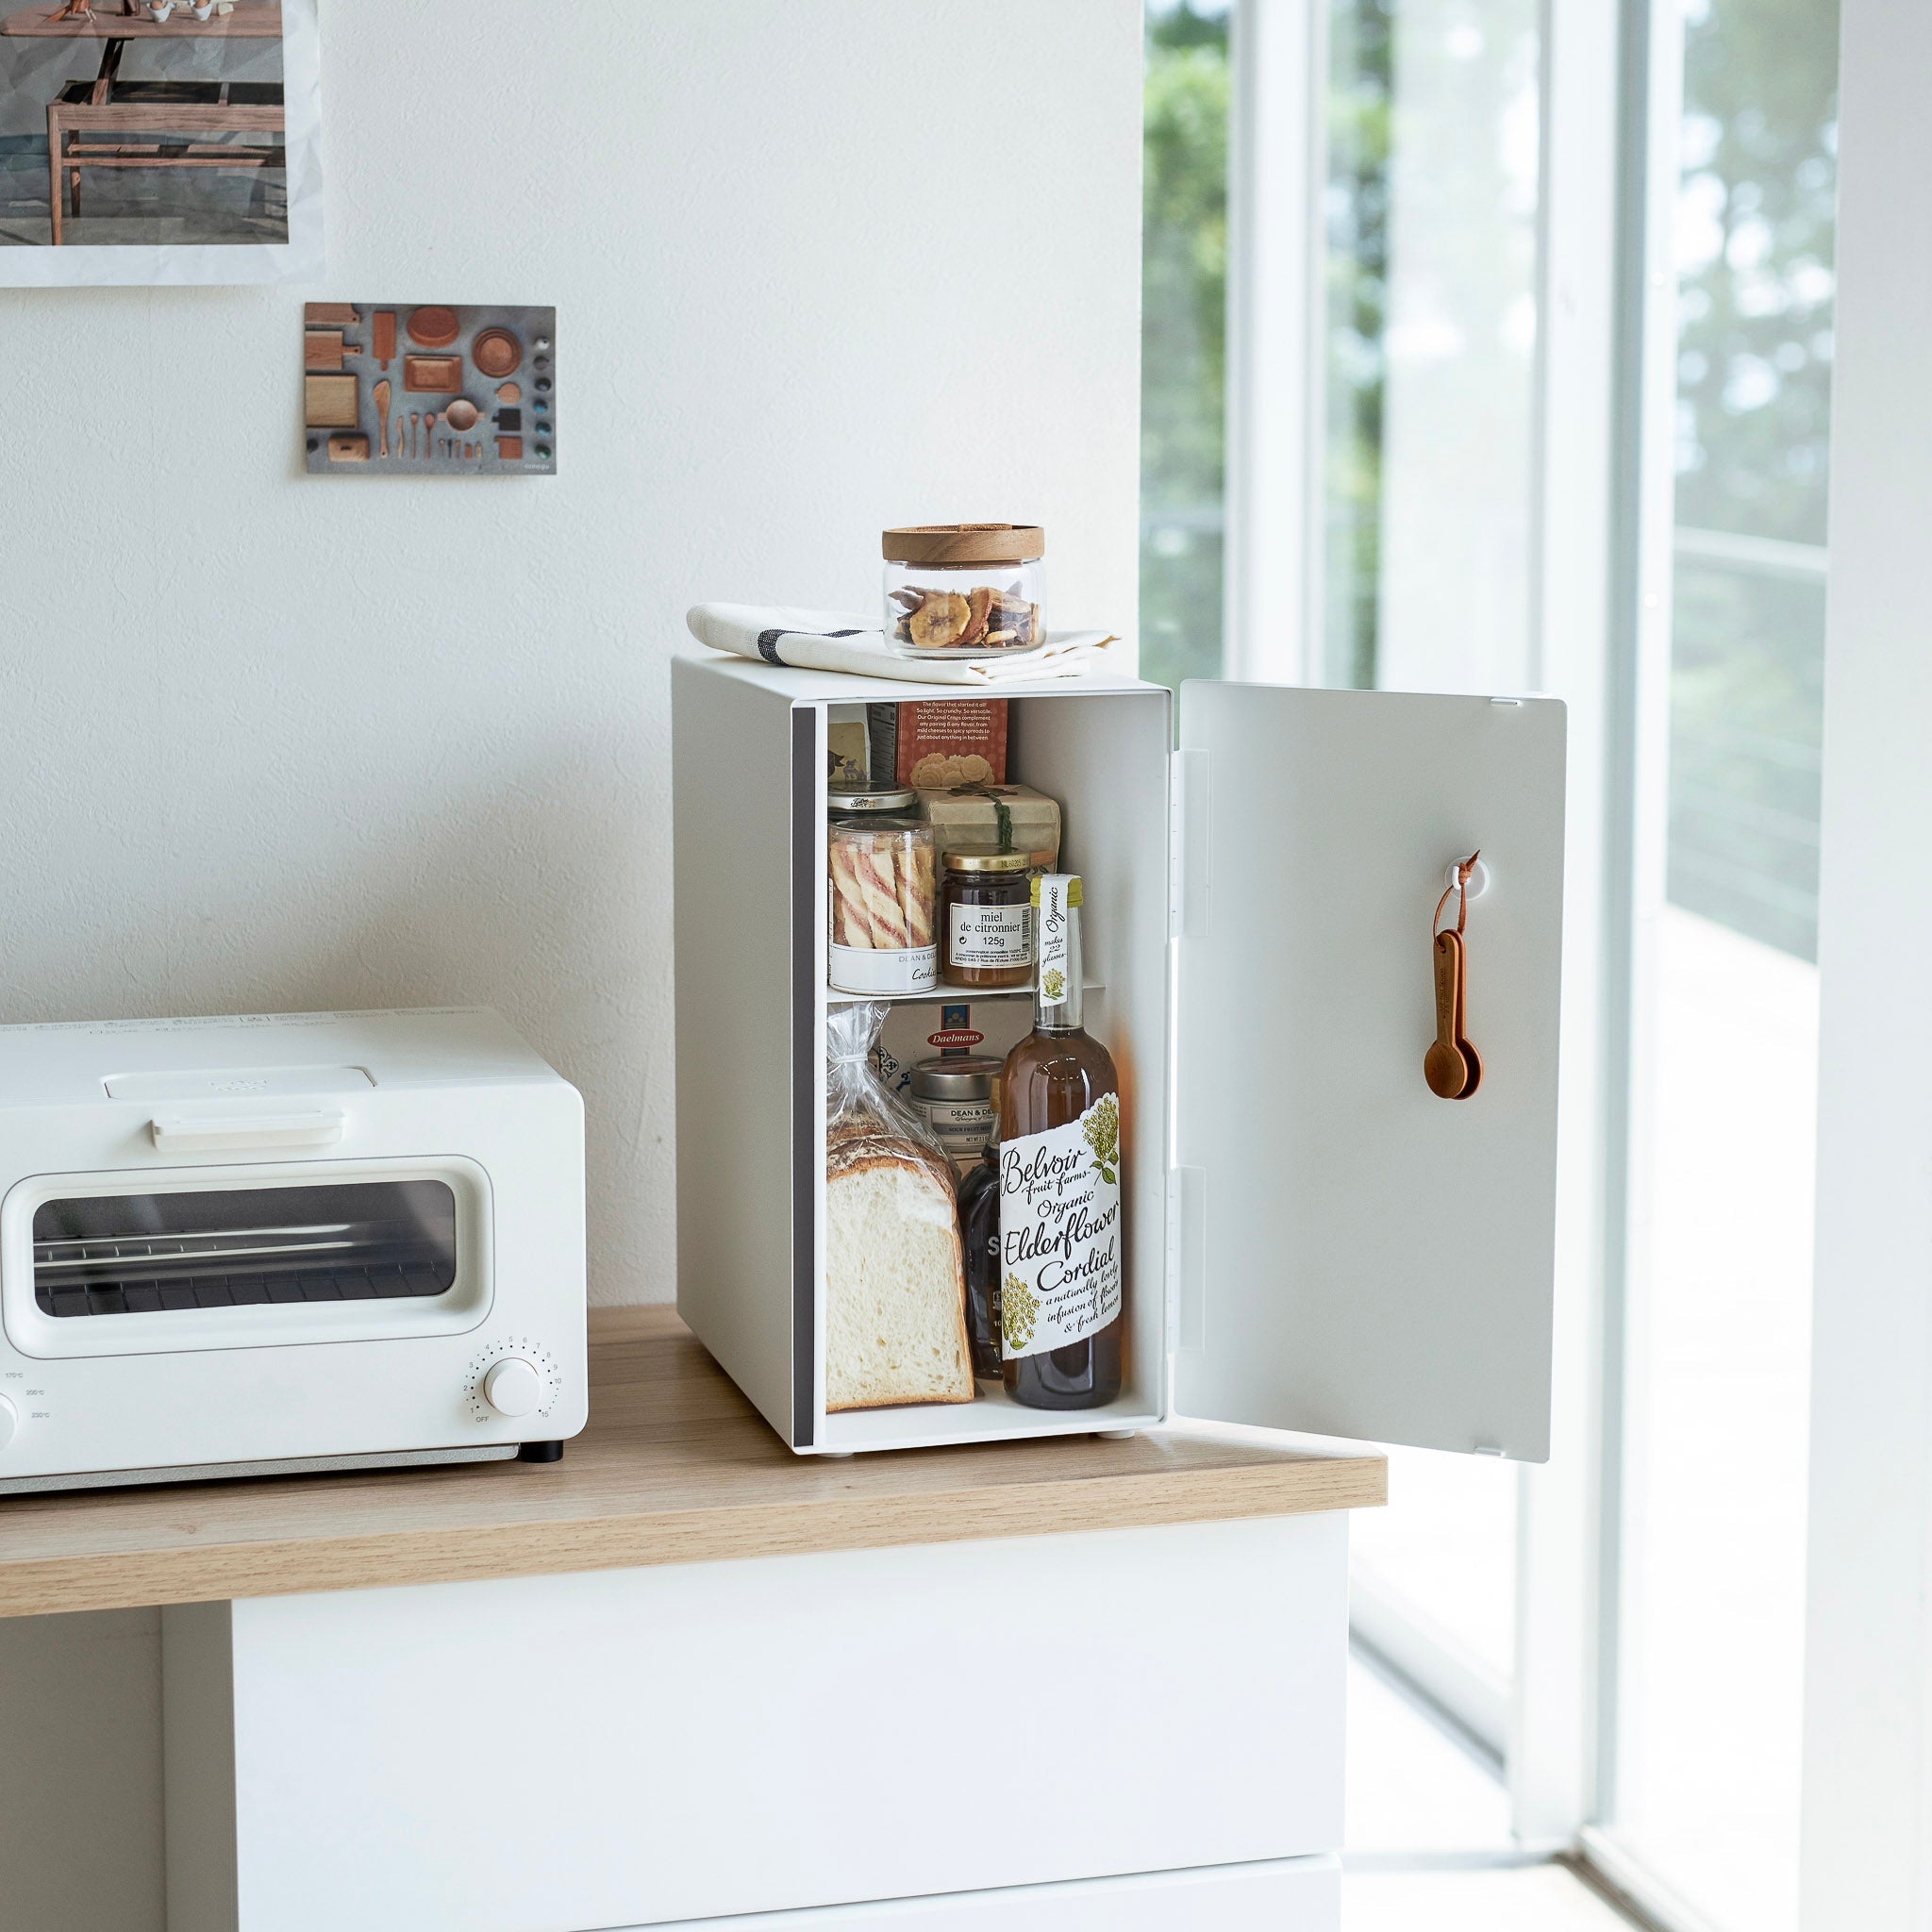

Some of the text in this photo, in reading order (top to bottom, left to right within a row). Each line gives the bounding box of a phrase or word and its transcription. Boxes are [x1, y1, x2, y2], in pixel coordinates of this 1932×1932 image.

[981, 912, 1002, 922] miel
[1046, 887, 1066, 933] Organic
[960, 922, 1020, 933] de citronnier
[983, 937, 1004, 947] 125g
[1045, 936, 1063, 946] makes
[1049, 944, 1060, 953] 22
[899, 955, 920, 963] DEAN
[932, 1034, 980, 1043] Daelmans
[1000, 1146, 1087, 1197] Belvoir
[1022, 1180, 1054, 1205] fruit
[1038, 1191, 1094, 1224] Organic
[1005, 1200, 1119, 1265] Elderflower
[988, 1236, 1000, 1256] S
[1037, 1235, 1114, 1291] Cordial
[1054, 1277, 1098, 1303] naturally
[1101, 1261, 1118, 1282] lovely
[1048, 1306, 1085, 1324] infusion
[1088, 1291, 1098, 1309] of
[1077, 1307, 1098, 1332] fresh
